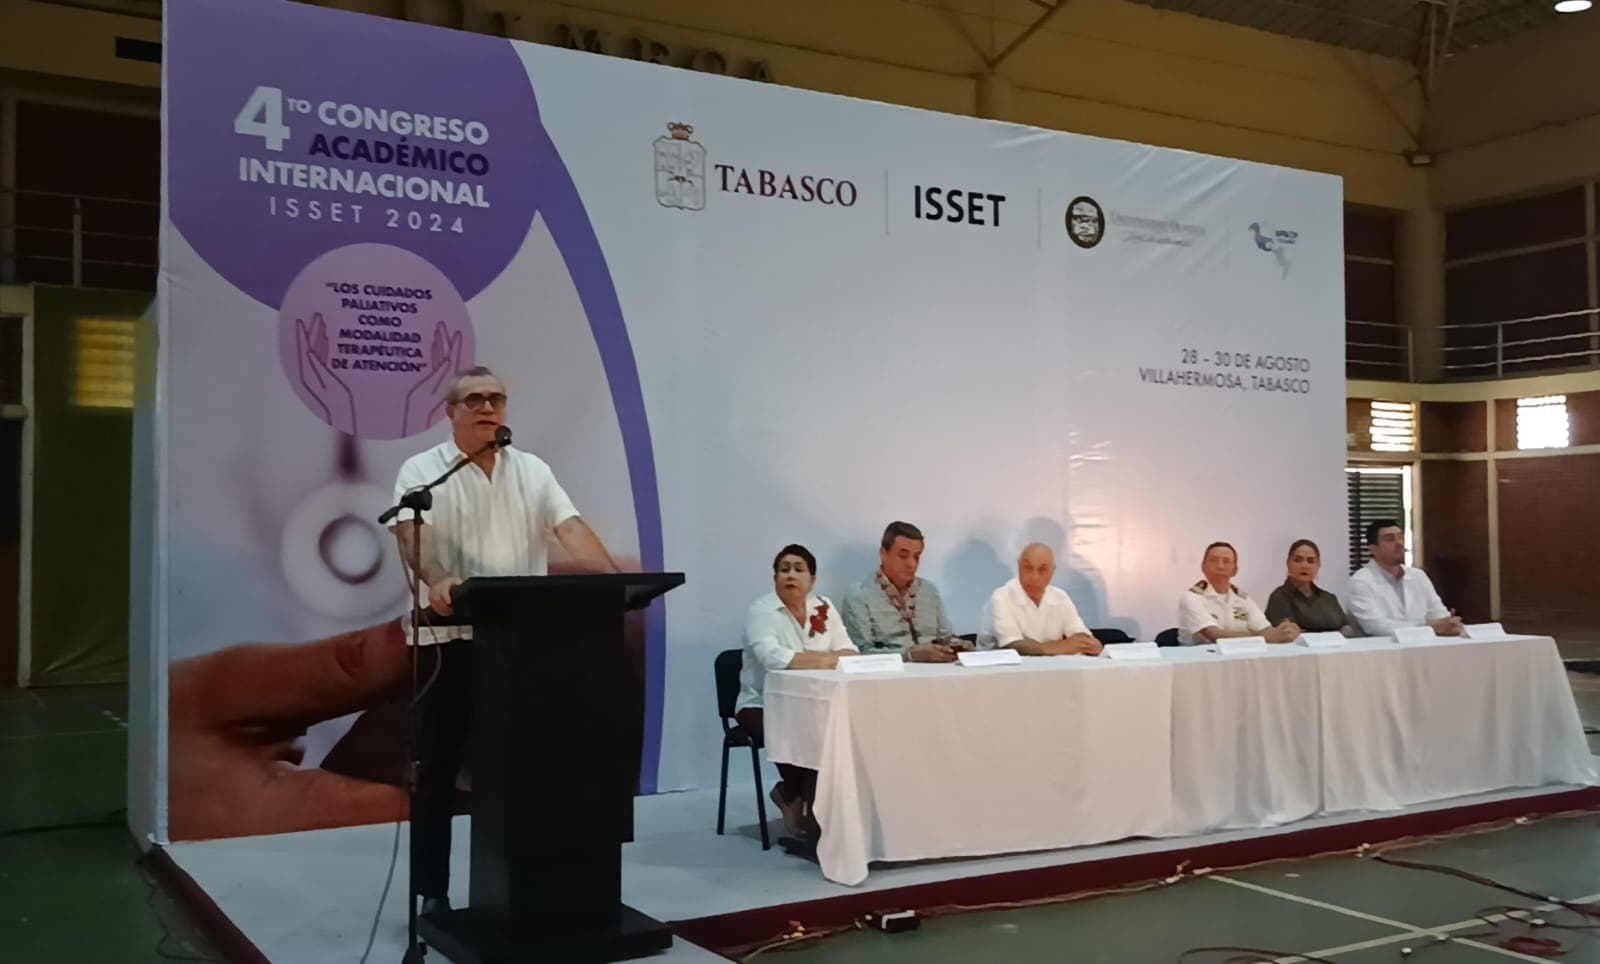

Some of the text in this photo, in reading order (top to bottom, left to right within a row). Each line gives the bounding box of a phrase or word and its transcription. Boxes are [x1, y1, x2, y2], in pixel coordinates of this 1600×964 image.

[318, 101, 489, 145] CONGRESO
[309, 133, 490, 176] ACADÉMICO
[239, 157, 490, 207] INTERNACIONAL
[714, 164, 857, 207] TABASCO
[270, 196, 464, 233] ISSET 2024
[914, 185, 1006, 227] ISSET
[341, 298, 418, 313] PALIATIVOS
[363, 285, 432, 300] CUIDADOS
[358, 314, 402, 327] COMO
[339, 328, 421, 343] MODALIDAD
[331, 358, 348, 369] DE
[1181, 348, 1198, 364] 28
[1215, 350, 1231, 367] 30
[1235, 352, 1251, 369] DE
[1255, 355, 1310, 373] AGOSTO
[1138, 367, 1310, 394] VILLAHERMOSA, TABASCO
